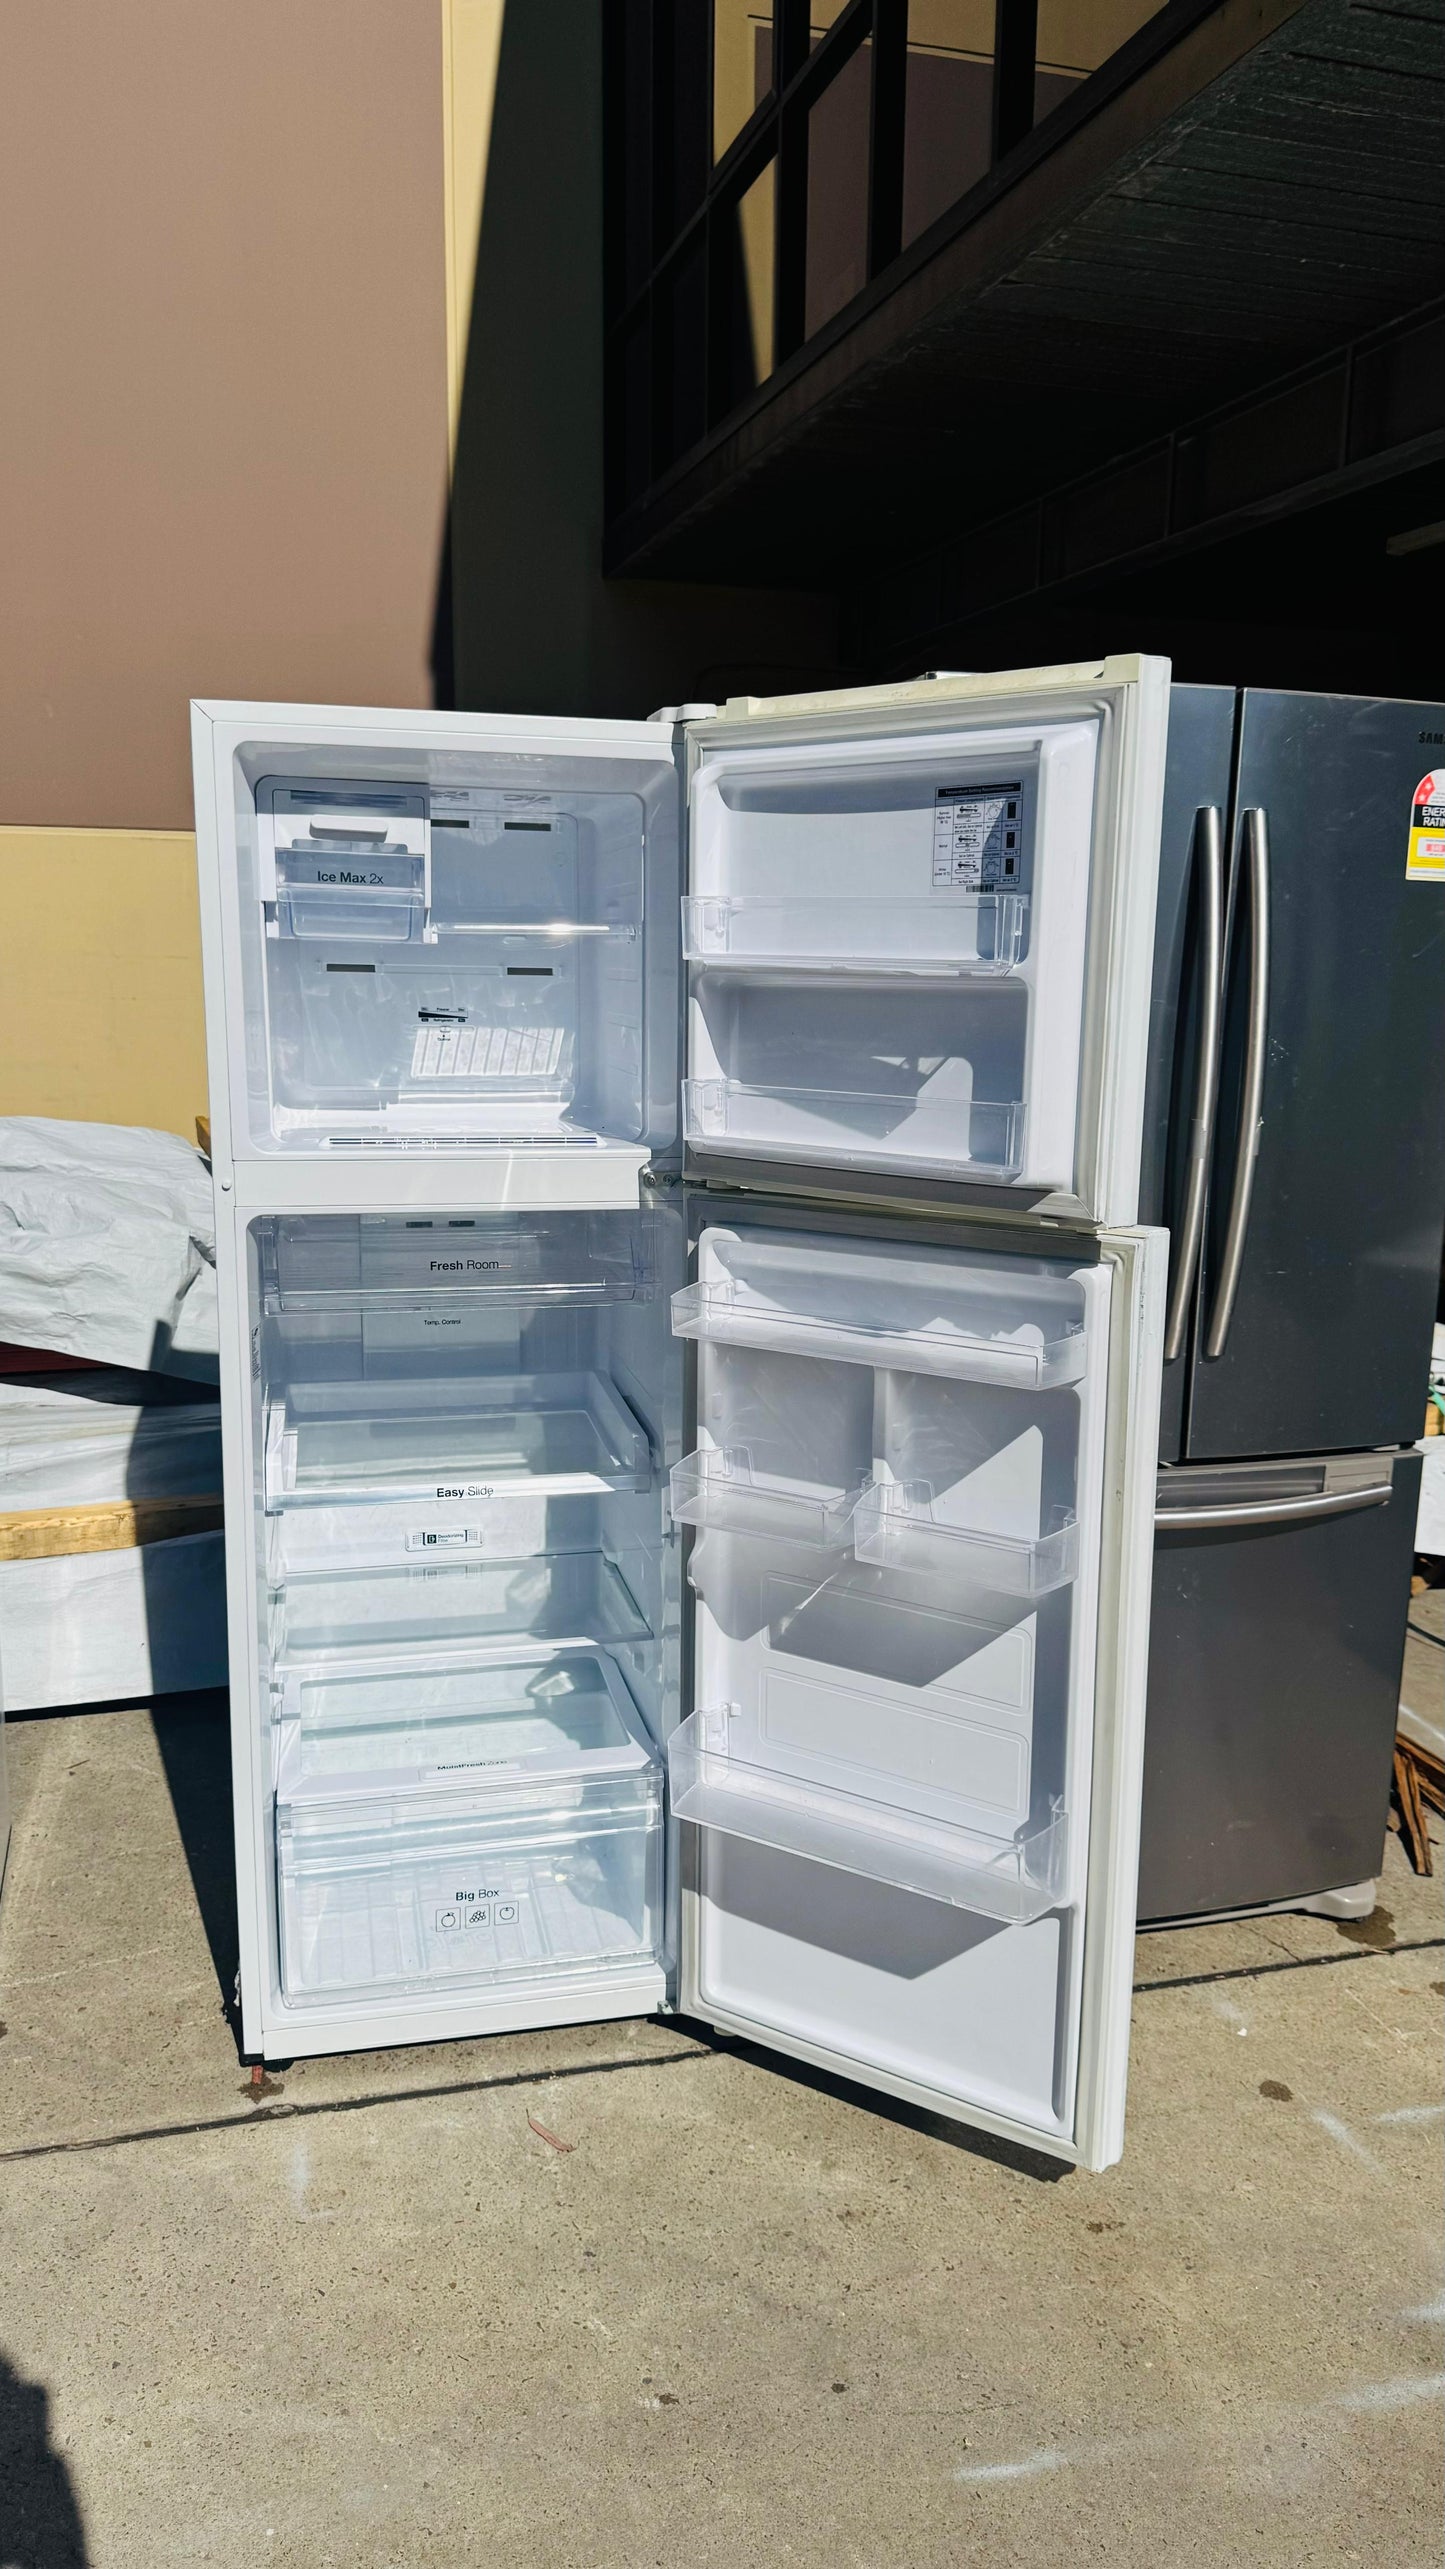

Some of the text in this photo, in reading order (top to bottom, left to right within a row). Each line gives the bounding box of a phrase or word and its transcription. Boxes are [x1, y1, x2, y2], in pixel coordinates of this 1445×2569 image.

[1419, 731, 1445, 745] SAM
[317, 870, 384, 884] Ice Max 2x
[430, 1259, 499, 1271] Fresh Room
[436, 1485, 494, 1498] Easy Slide
[455, 1888, 500, 1902] Big Box
